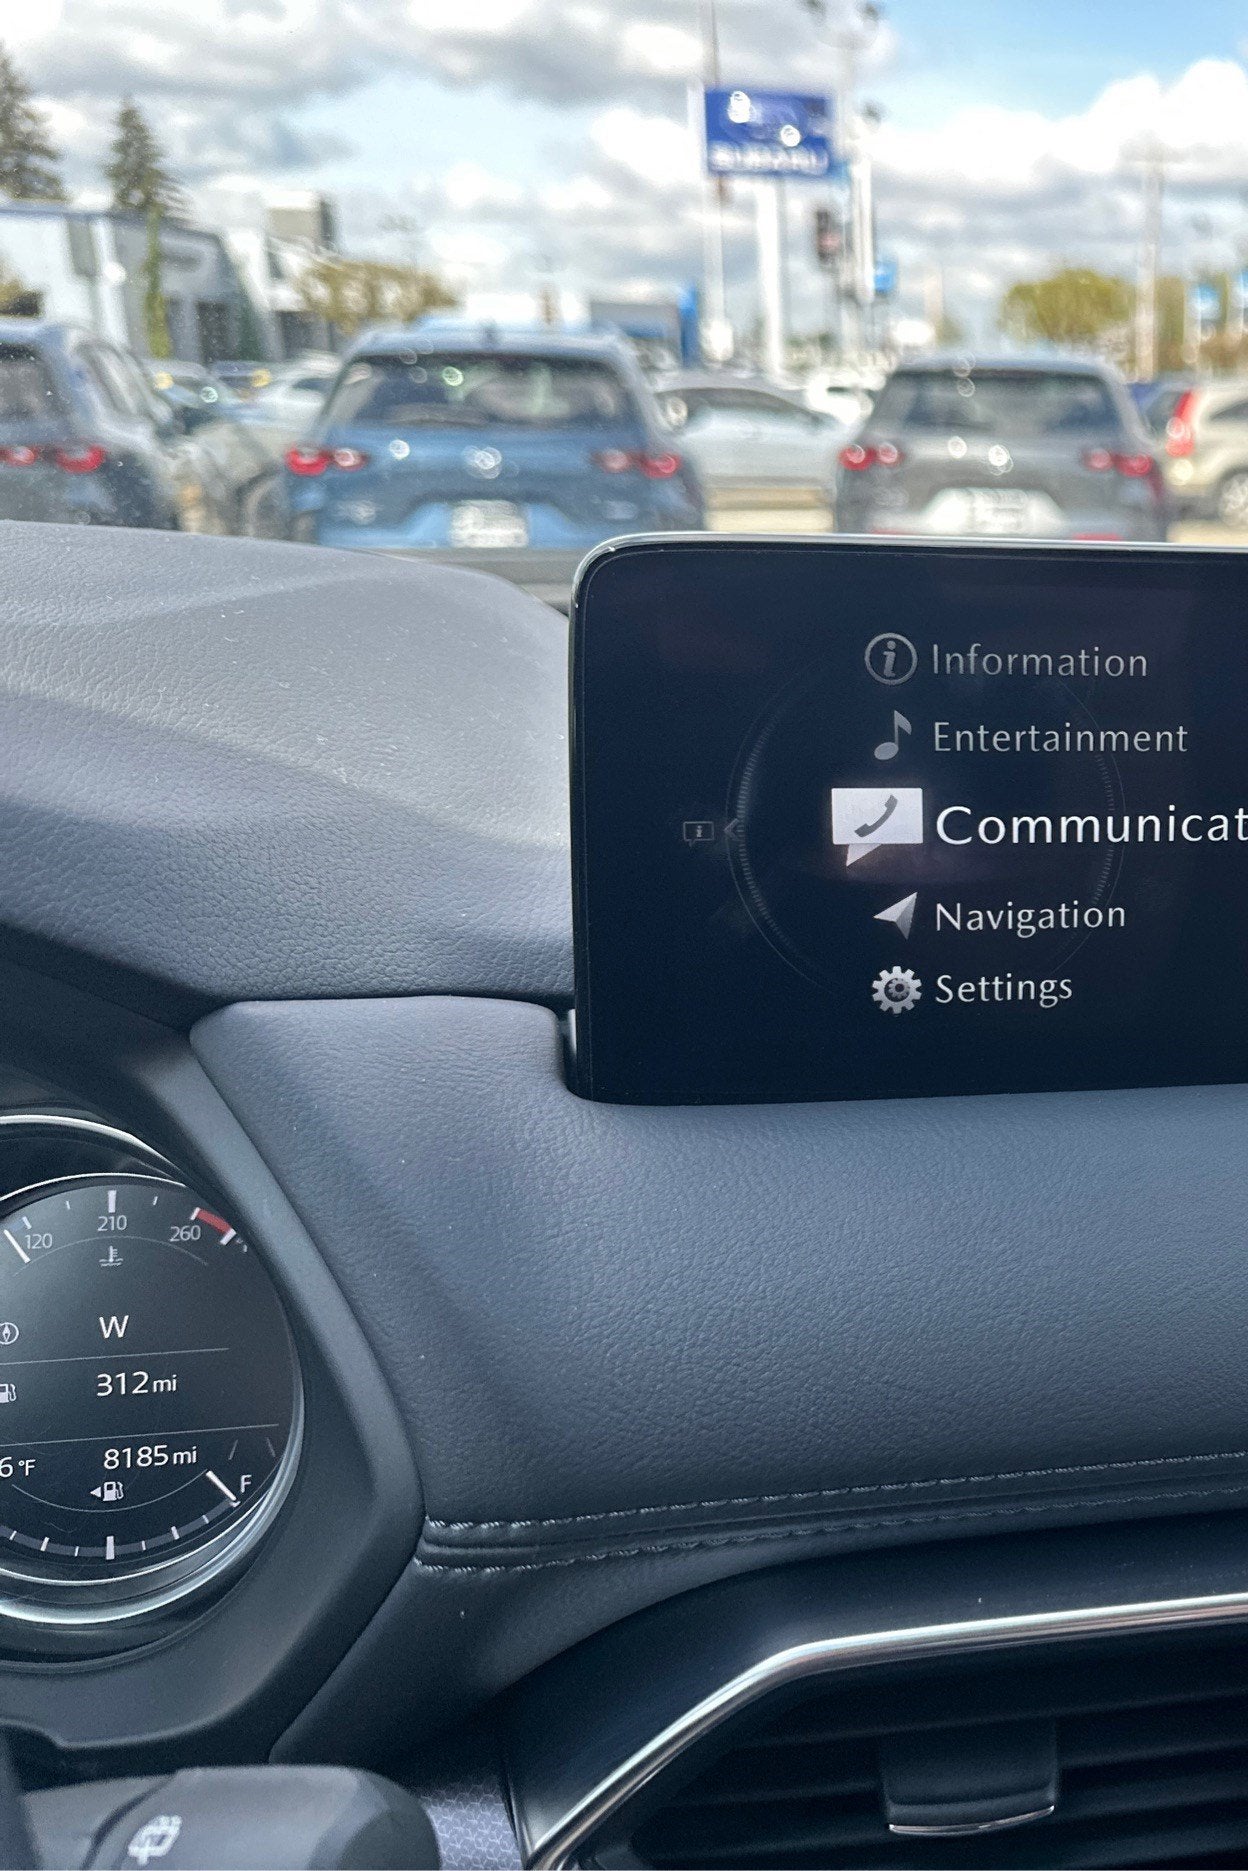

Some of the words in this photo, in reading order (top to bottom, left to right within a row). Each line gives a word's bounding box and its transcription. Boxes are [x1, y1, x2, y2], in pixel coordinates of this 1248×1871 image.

[933, 642, 1147, 677] Information
[934, 721, 1188, 752] Entertainment
[936, 899, 1125, 939] Navigation
[935, 972, 1073, 1008] Settings
[97, 1214, 128, 1232] 210
[169, 1224, 201, 1242] 260
[24, 1233, 53, 1250] 120
[98, 1314, 129, 1339] W
[240, 1474, 252, 1494] F
